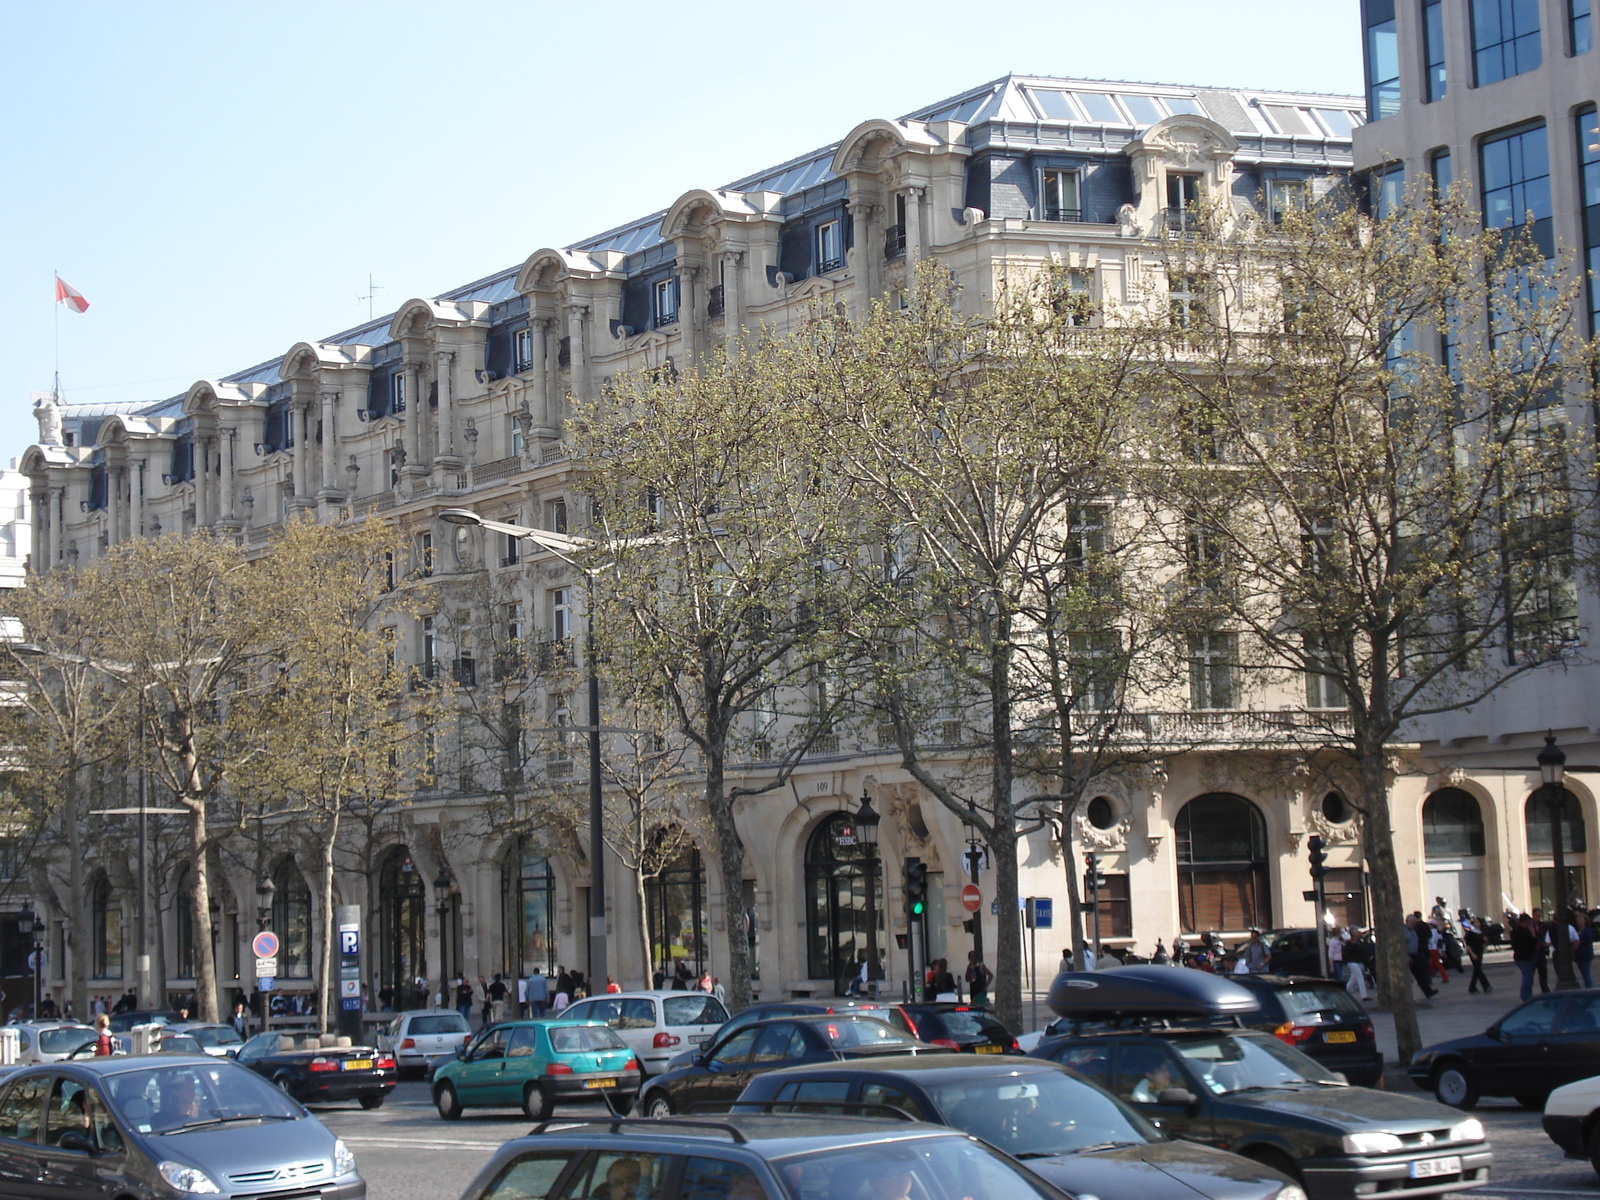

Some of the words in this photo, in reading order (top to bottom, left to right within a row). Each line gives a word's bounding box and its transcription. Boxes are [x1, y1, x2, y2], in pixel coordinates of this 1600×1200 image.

[816, 782, 829, 793] 109
[839, 836, 857, 846] HSBC
[1035, 908, 1052, 918] TAXIS
[342, 932, 357, 953] P
